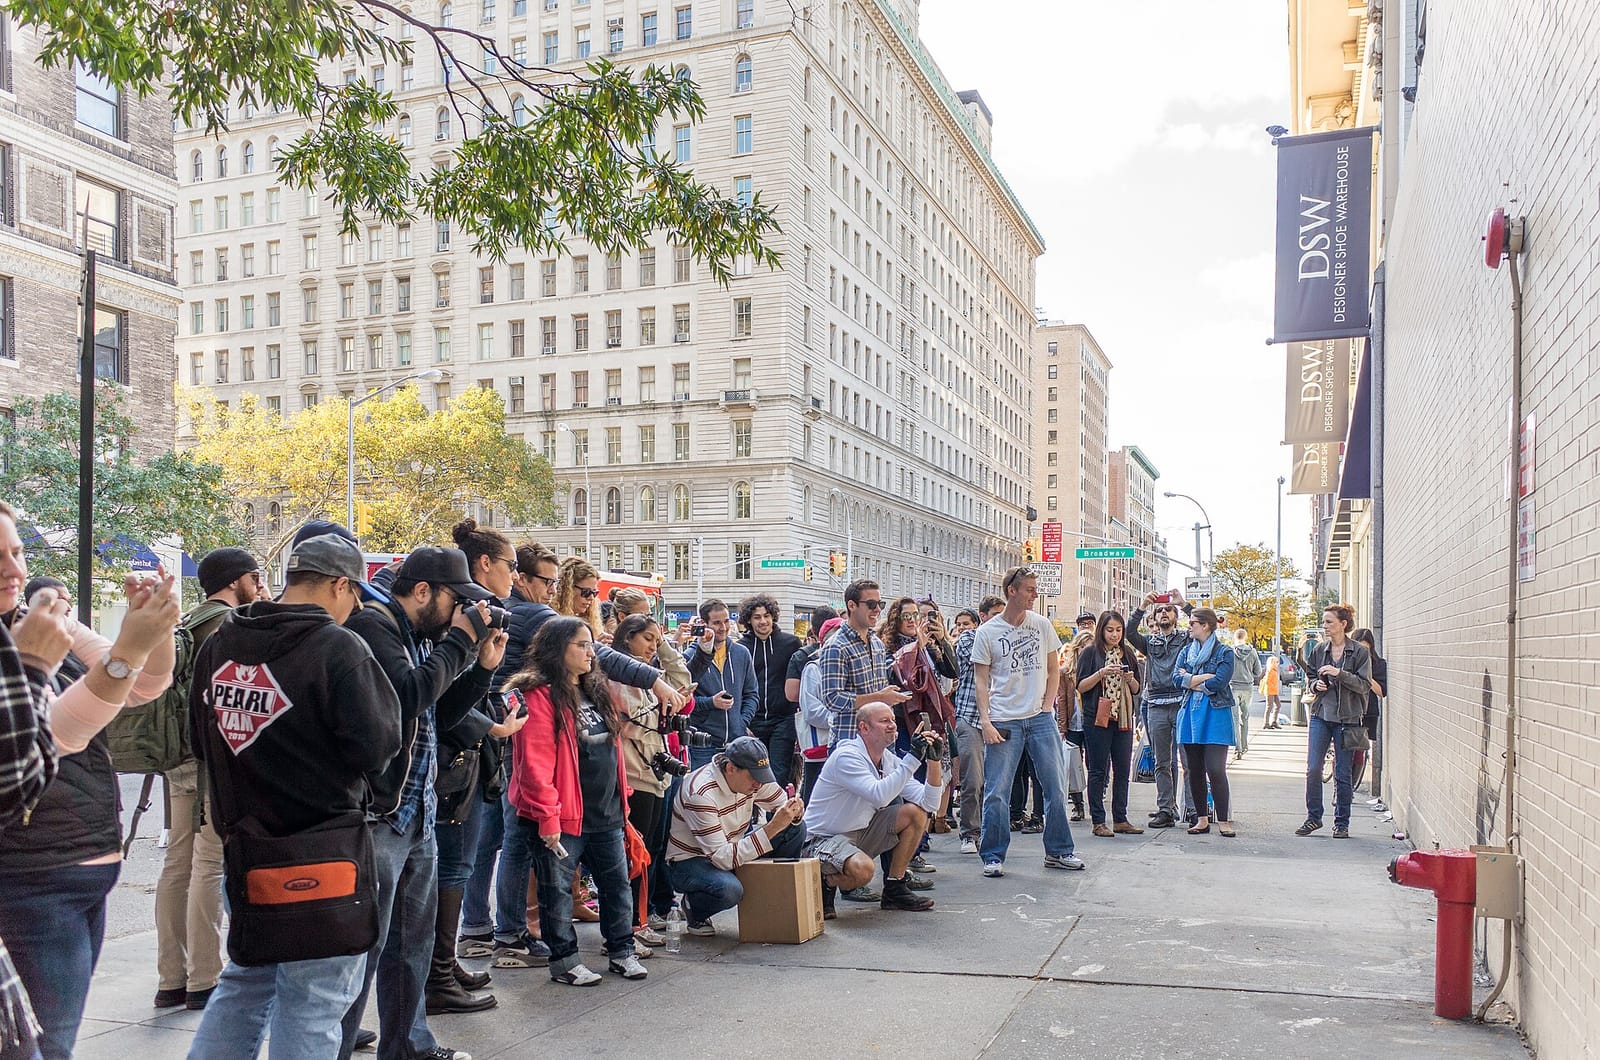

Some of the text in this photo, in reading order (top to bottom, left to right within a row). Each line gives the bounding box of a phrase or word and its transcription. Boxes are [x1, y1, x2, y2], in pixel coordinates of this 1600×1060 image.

[1298, 193, 1331, 283] DSW
[1334, 146, 1349, 322] DESIGNER SHOE WAREHOUSE
[1301, 344, 1323, 404] DSW
[1325, 366, 1334, 389] SHOE
[1324, 390, 1333, 432] DESIGNER
[214, 683, 270, 714] PEARL
